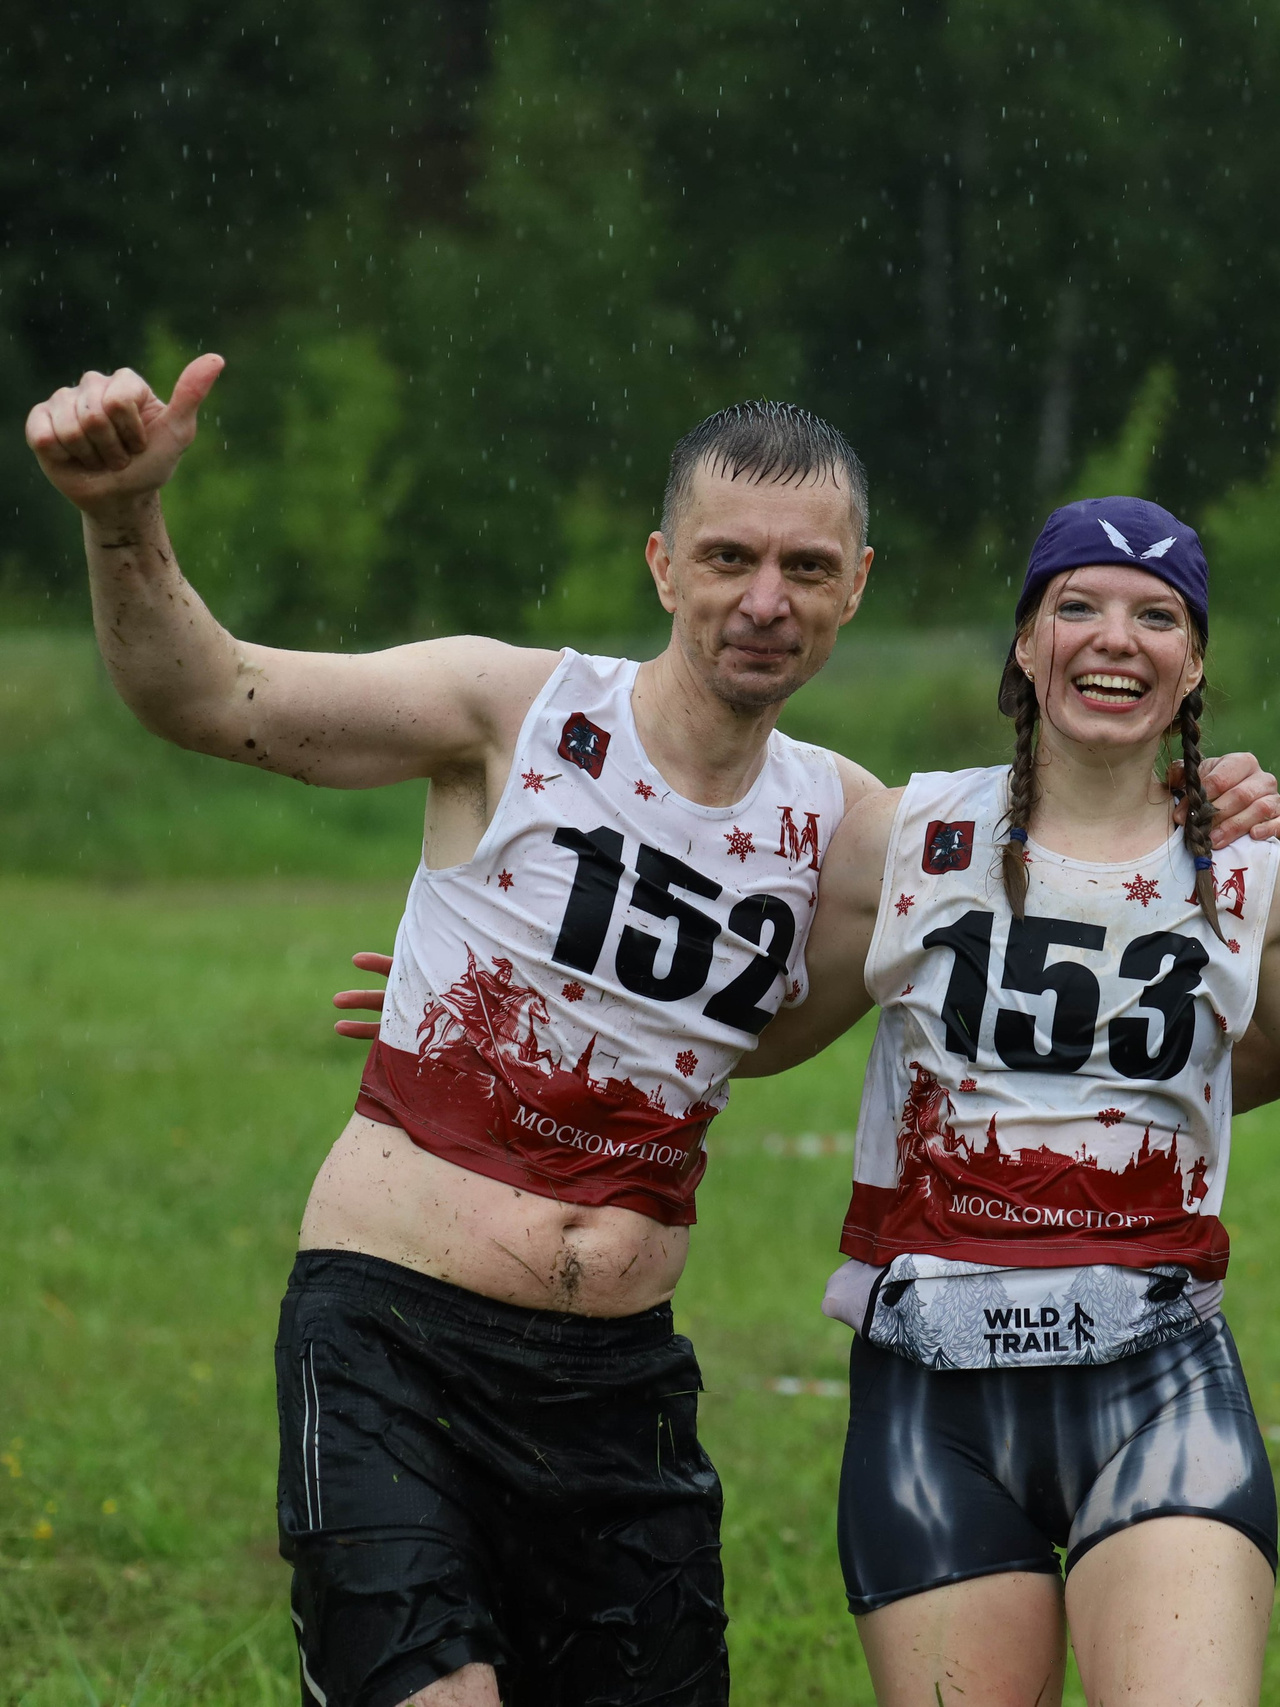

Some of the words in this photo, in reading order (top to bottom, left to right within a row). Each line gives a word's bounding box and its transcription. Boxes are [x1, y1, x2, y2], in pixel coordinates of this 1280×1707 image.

[552, 825, 796, 1036] 152
[923, 910, 1210, 1080] 153
[949, 1194, 1155, 1229] МОСКОМСПОРТ
[983, 1307, 1060, 1330] WILD
[983, 1331, 1069, 1354] TRAIL
